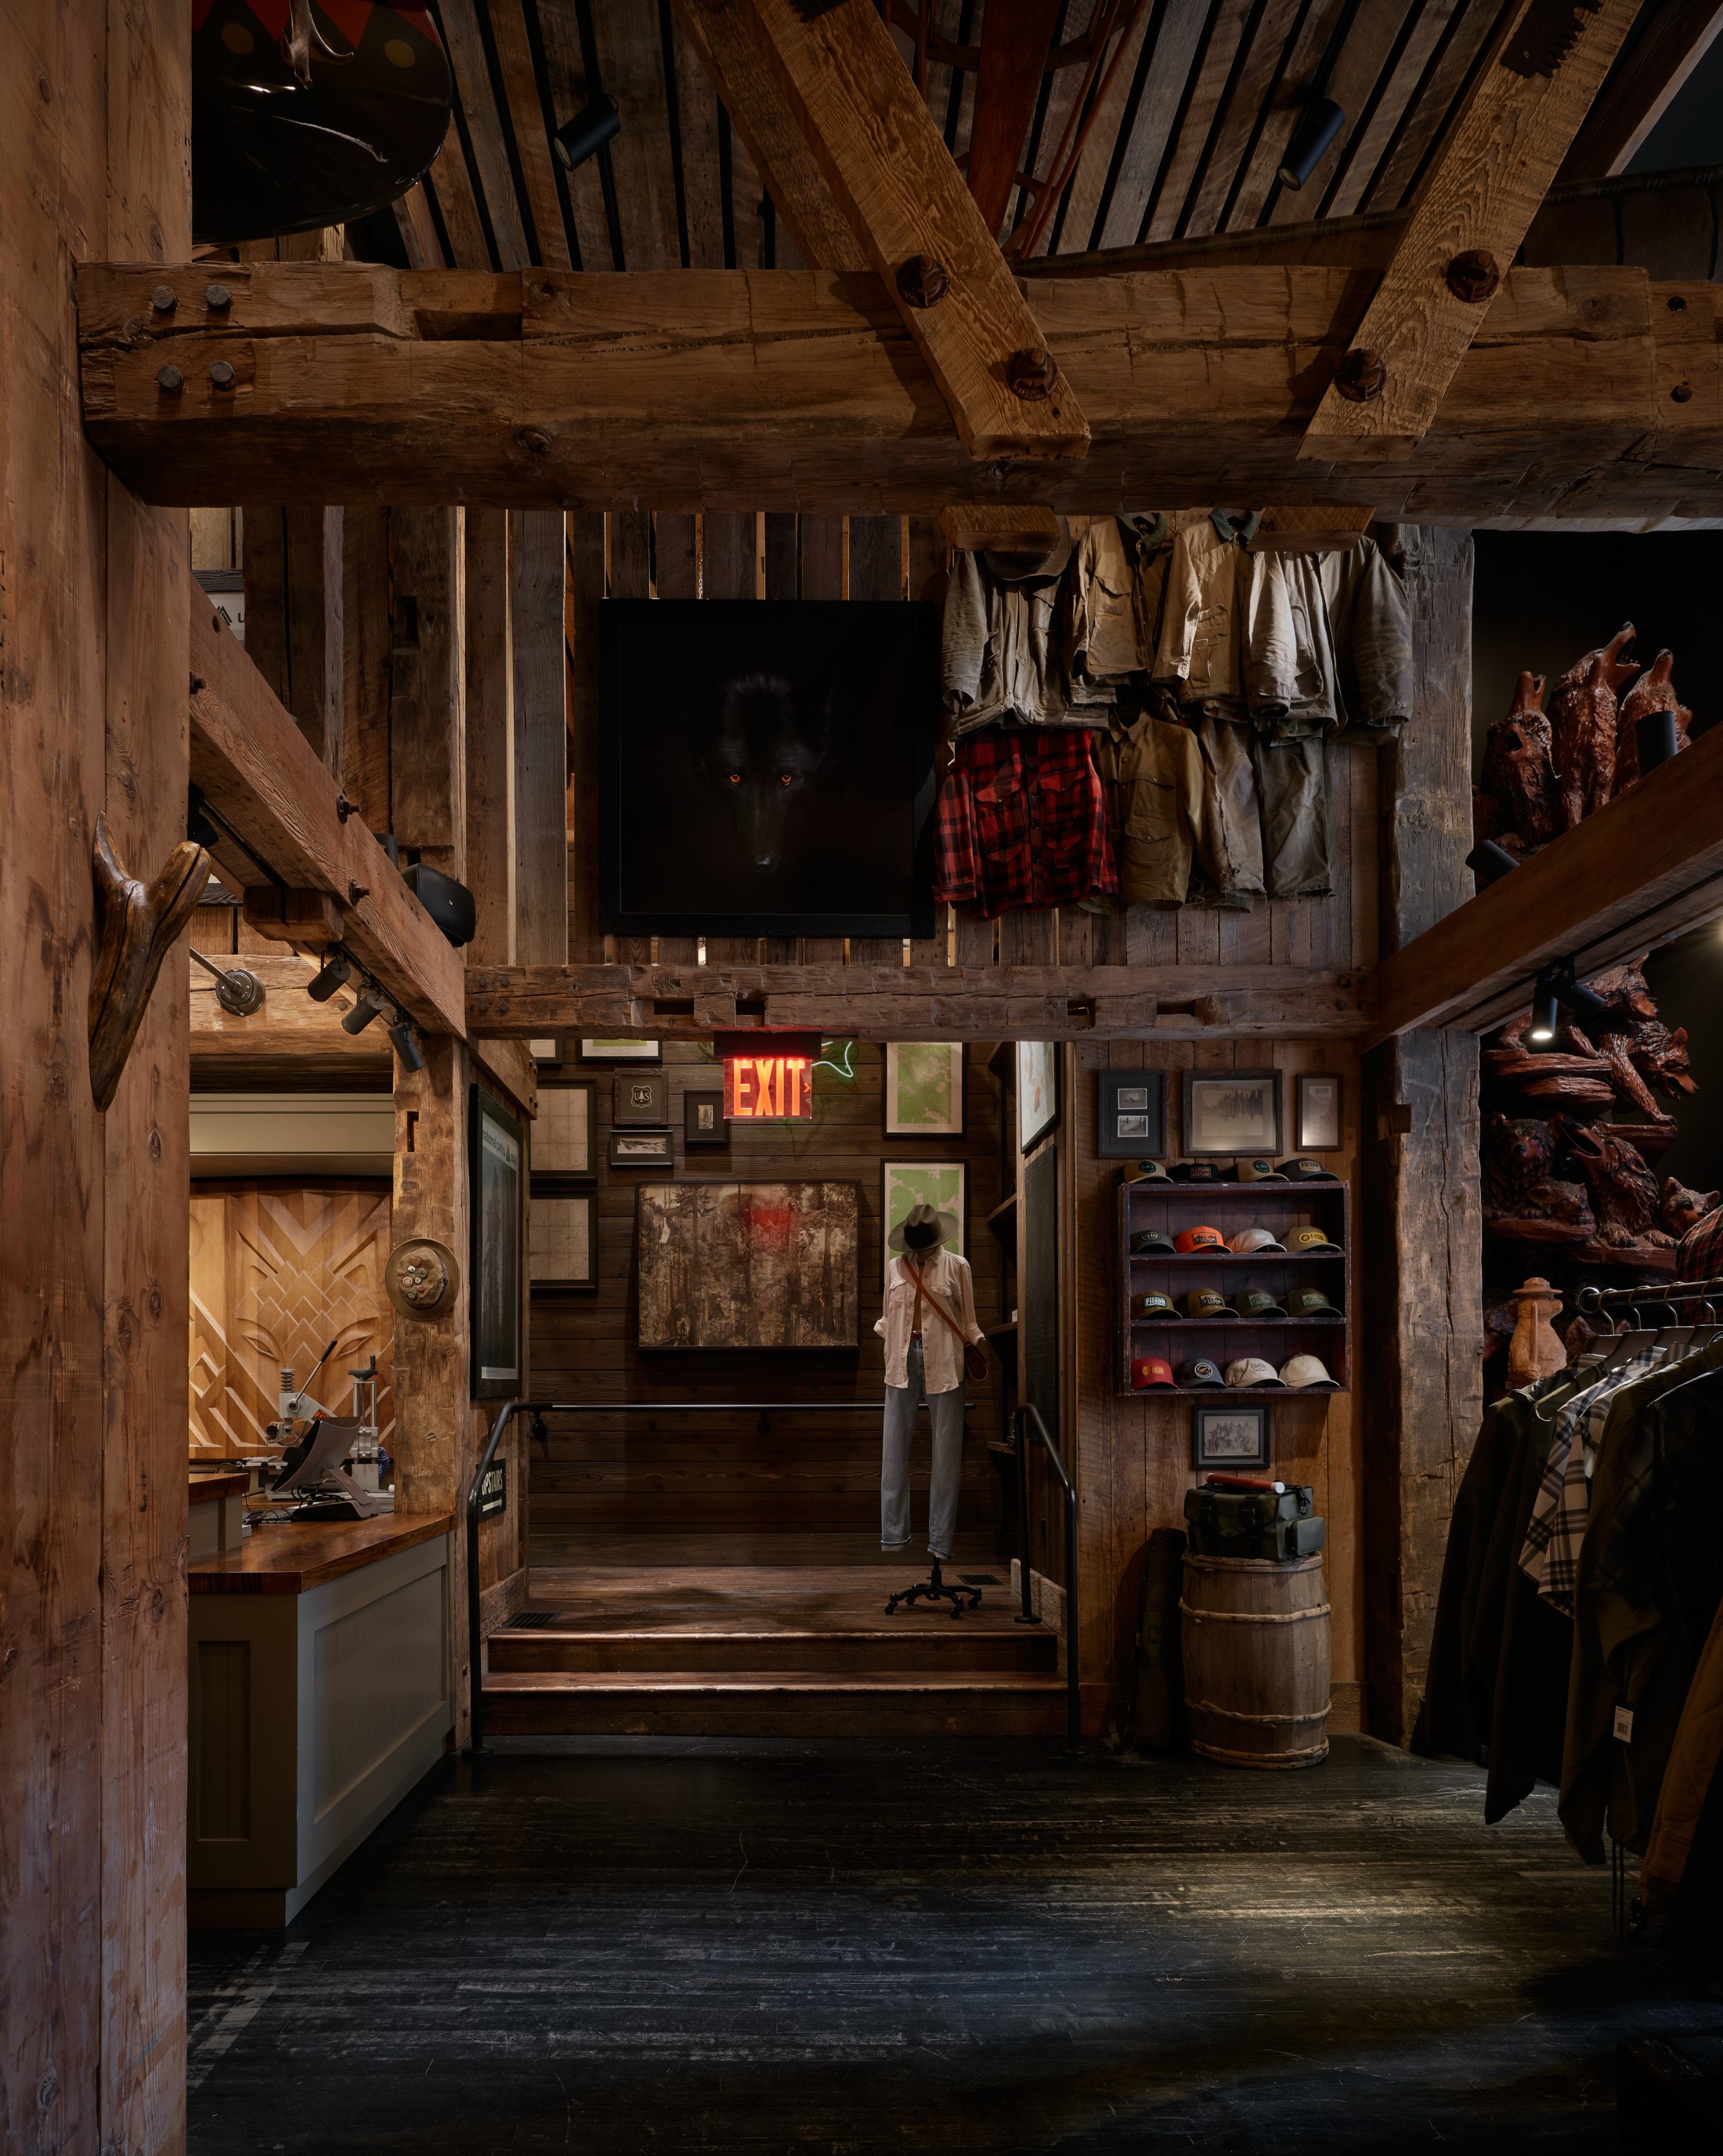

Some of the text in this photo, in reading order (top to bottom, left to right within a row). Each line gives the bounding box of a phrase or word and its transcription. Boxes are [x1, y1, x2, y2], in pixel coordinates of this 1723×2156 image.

[734, 1060, 806, 1116] EXIT
[1146, 1297, 1166, 1306] Filson
[482, 1468, 503, 1496] UPSTAIRS
